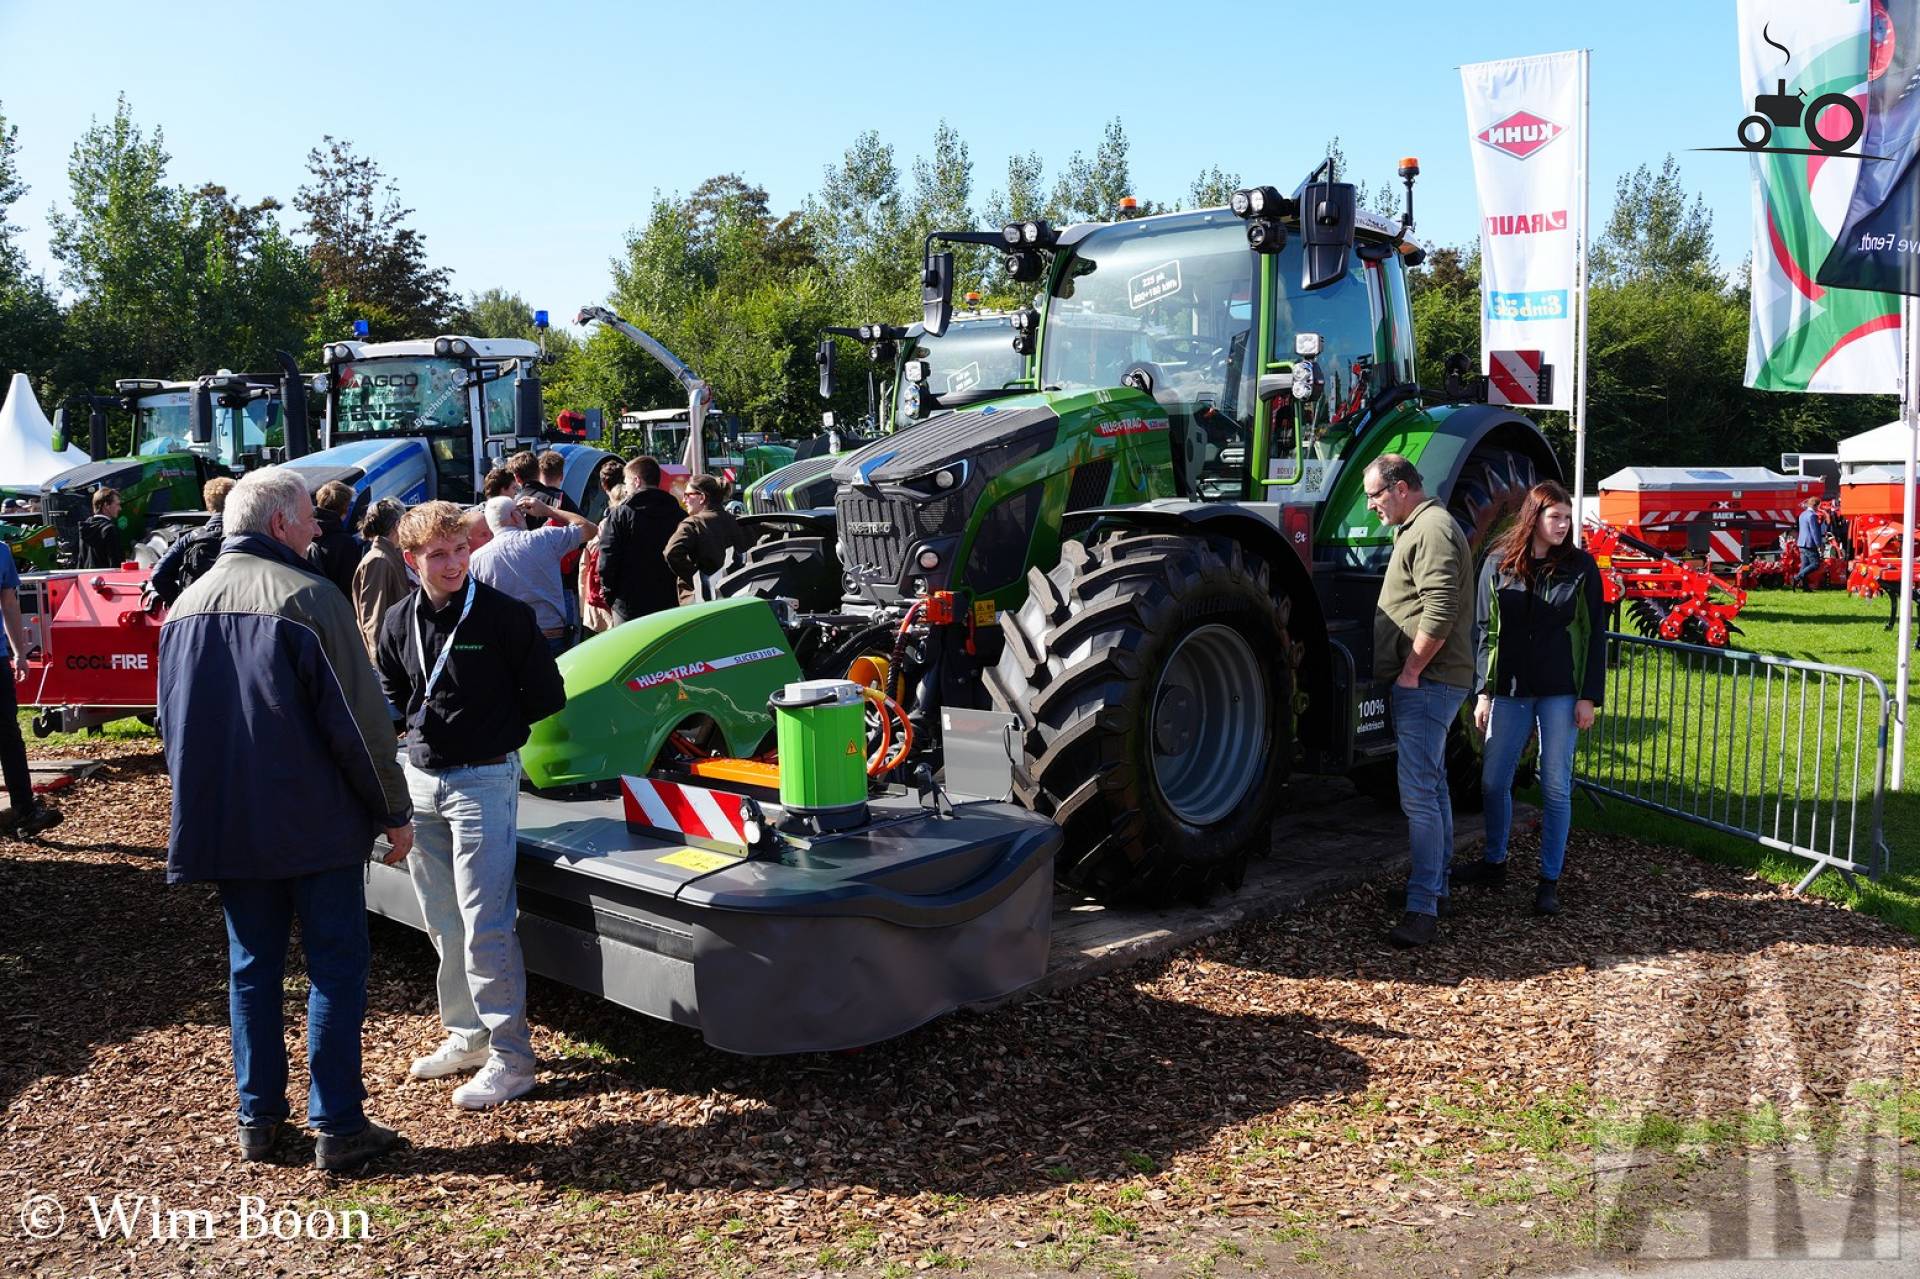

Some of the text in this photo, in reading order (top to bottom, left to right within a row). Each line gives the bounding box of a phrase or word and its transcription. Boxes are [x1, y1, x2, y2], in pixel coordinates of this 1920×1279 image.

[361, 373, 418, 388] AGCO
[734, 652, 759, 664] SLICER
[1357, 698, 1385, 718] 100%
